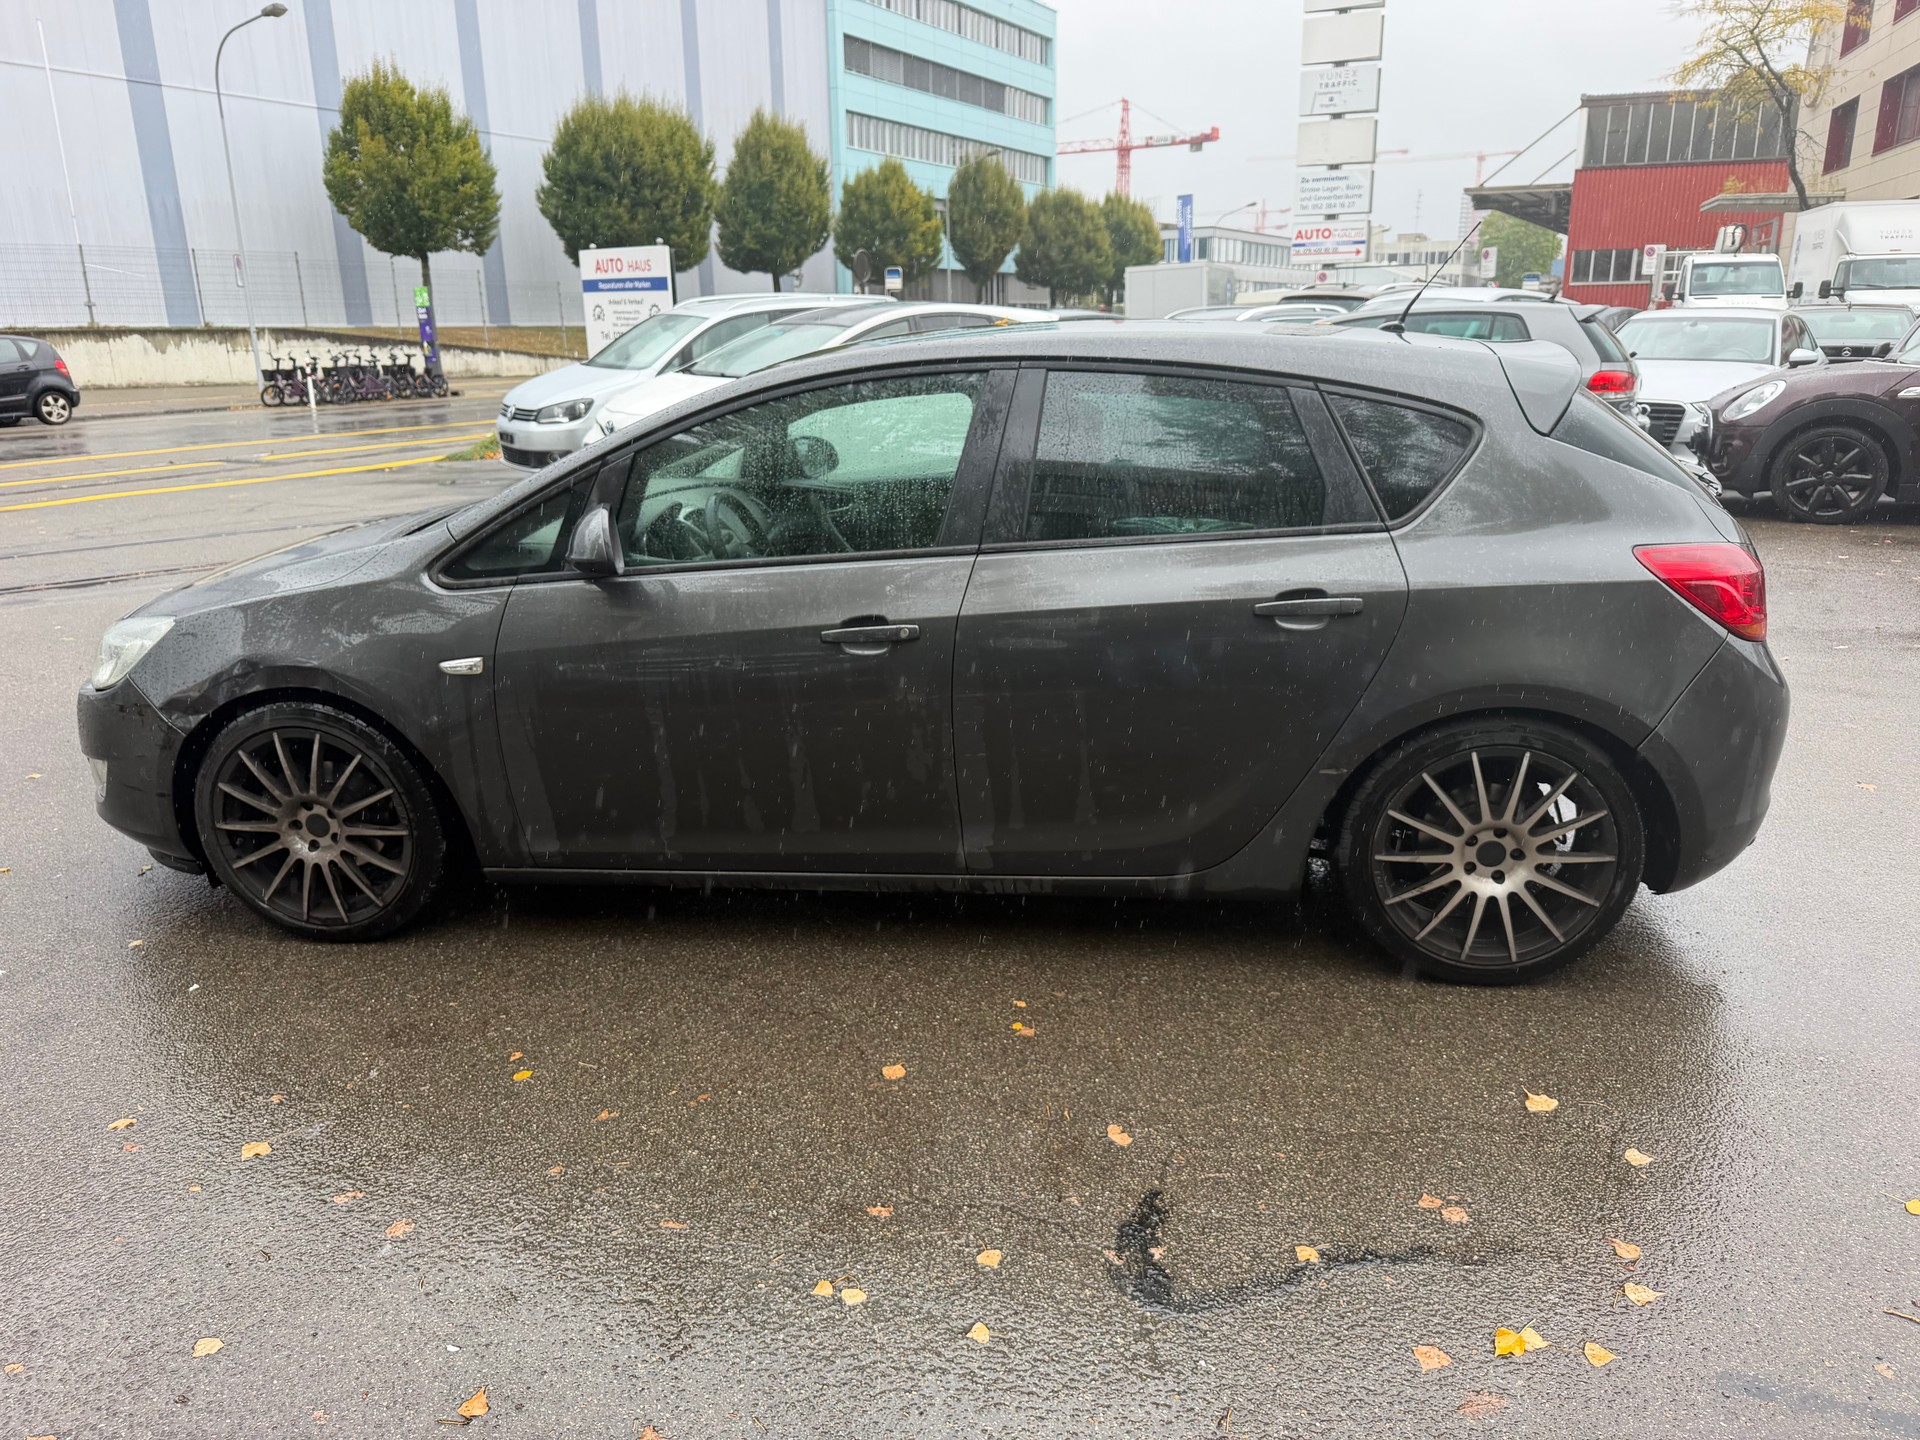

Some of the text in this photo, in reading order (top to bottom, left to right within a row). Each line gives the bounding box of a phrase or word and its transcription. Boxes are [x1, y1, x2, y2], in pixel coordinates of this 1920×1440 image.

[1318, 79, 1358, 89] TRAFFIC
[1295, 228, 1332, 240] AUTO
[595, 257, 652, 274] AUTO HAUS
